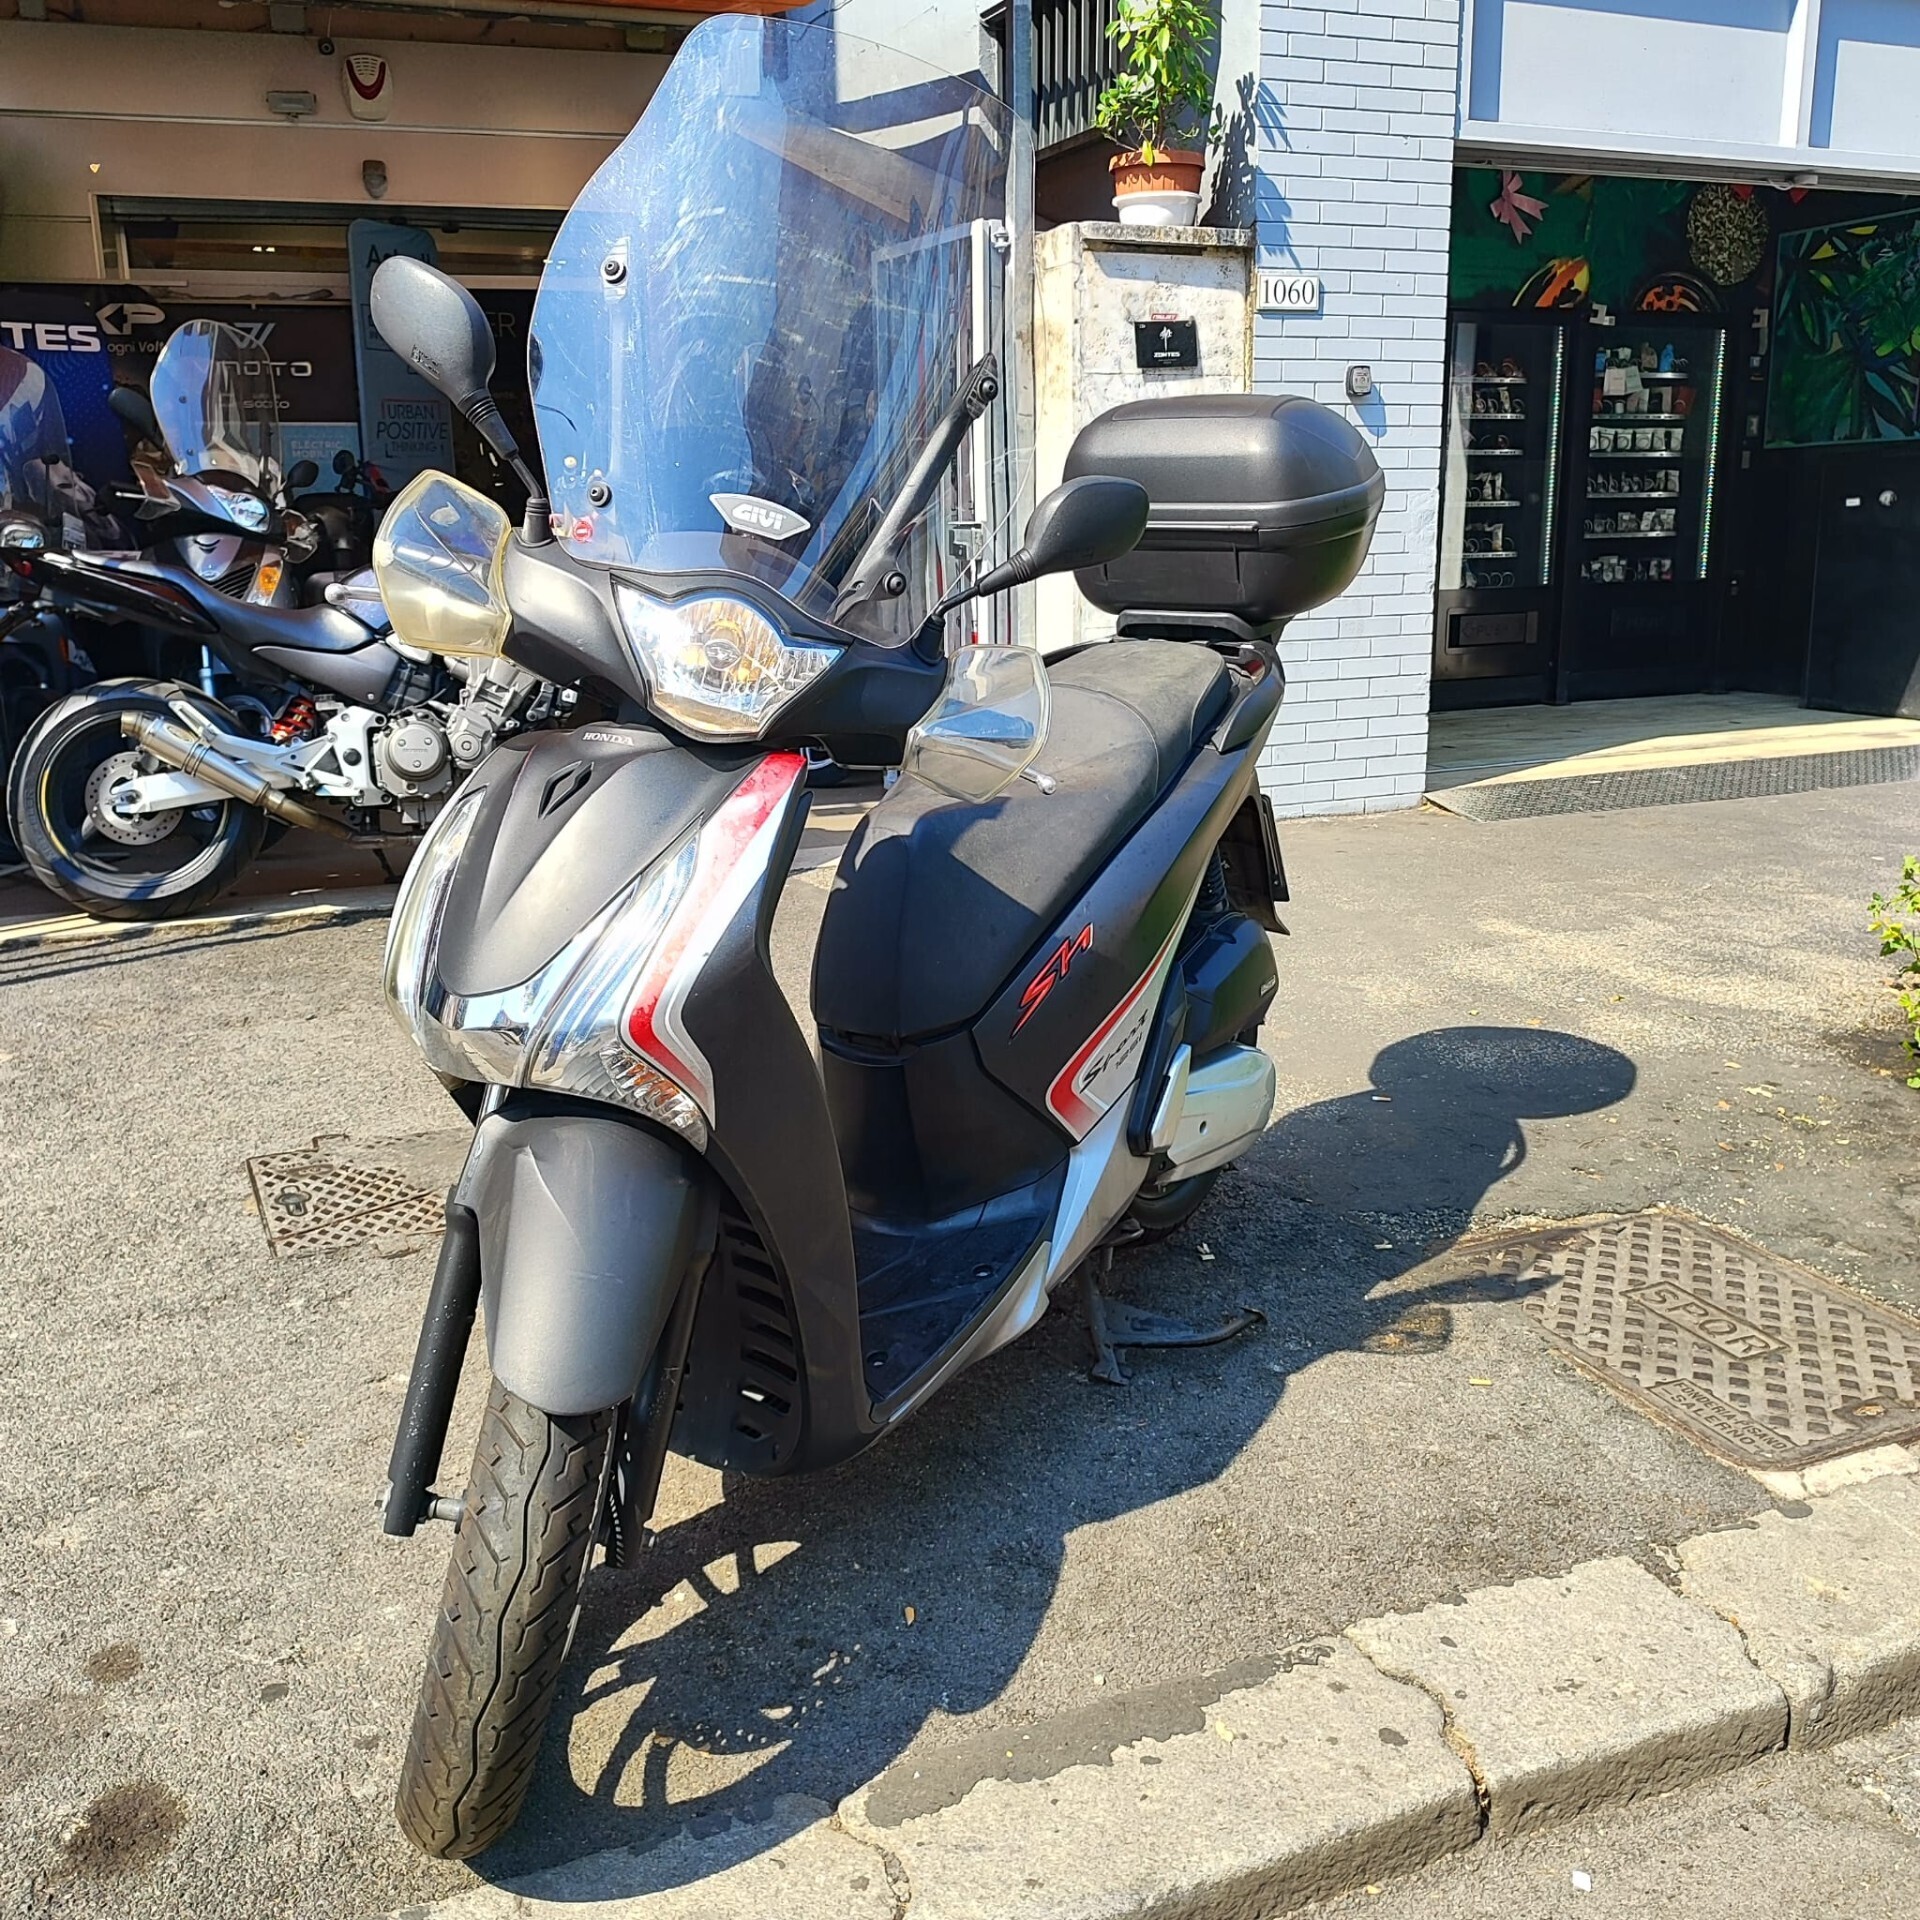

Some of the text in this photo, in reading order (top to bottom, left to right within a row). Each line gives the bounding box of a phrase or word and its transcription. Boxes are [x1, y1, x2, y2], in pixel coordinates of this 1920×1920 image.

[1263, 279, 1315, 304] 1060
[107, 342, 135, 356] ogni
[387, 404, 434, 420] URBAN
[376, 422, 448, 440] POSITIVE
[290, 440, 343, 450] ELECTRIC
[732, 503, 788, 531] GIVI
[582, 732, 635, 747] HONDA
